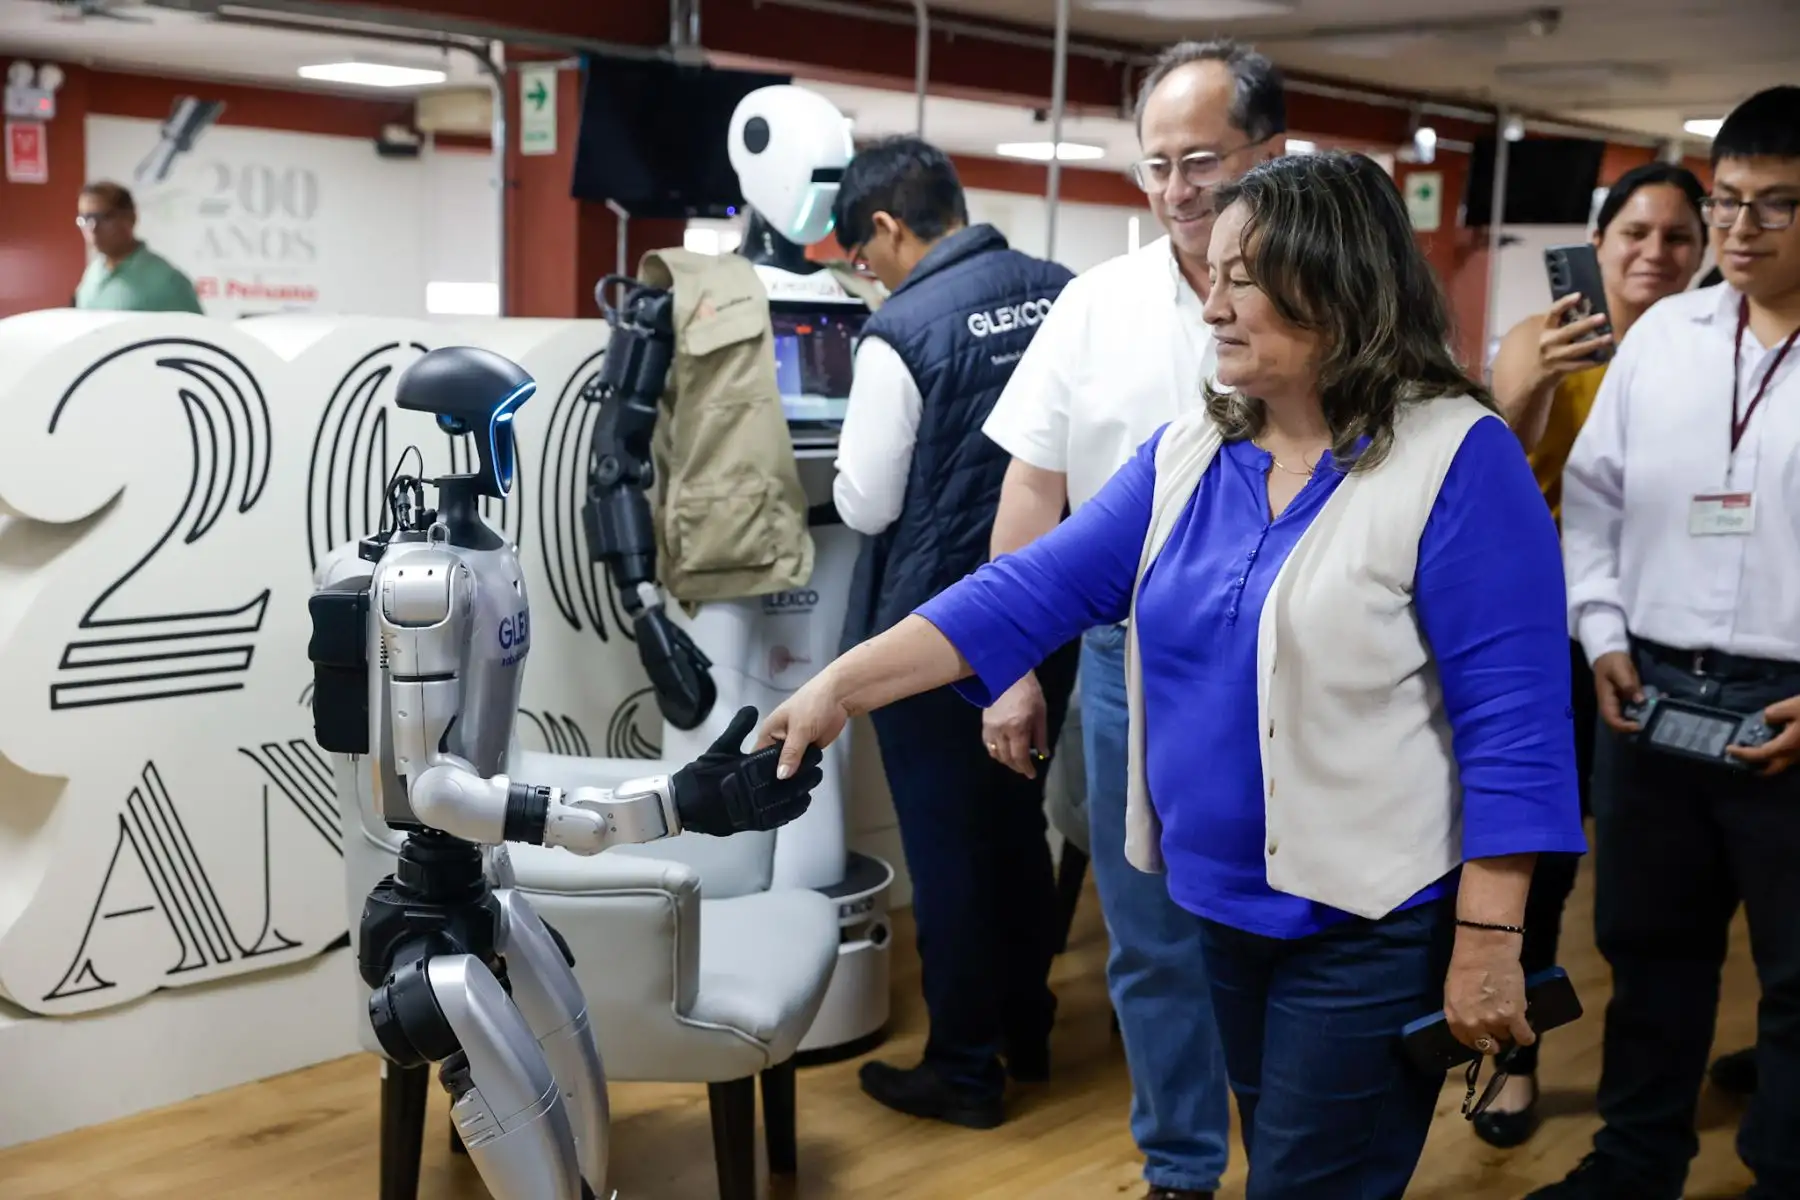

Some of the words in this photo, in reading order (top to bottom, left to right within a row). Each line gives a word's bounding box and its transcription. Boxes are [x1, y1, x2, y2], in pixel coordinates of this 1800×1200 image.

[199, 161, 319, 221] 200
[967, 297, 1052, 337] GLEXCO
[762, 590, 819, 608] LEXCO
